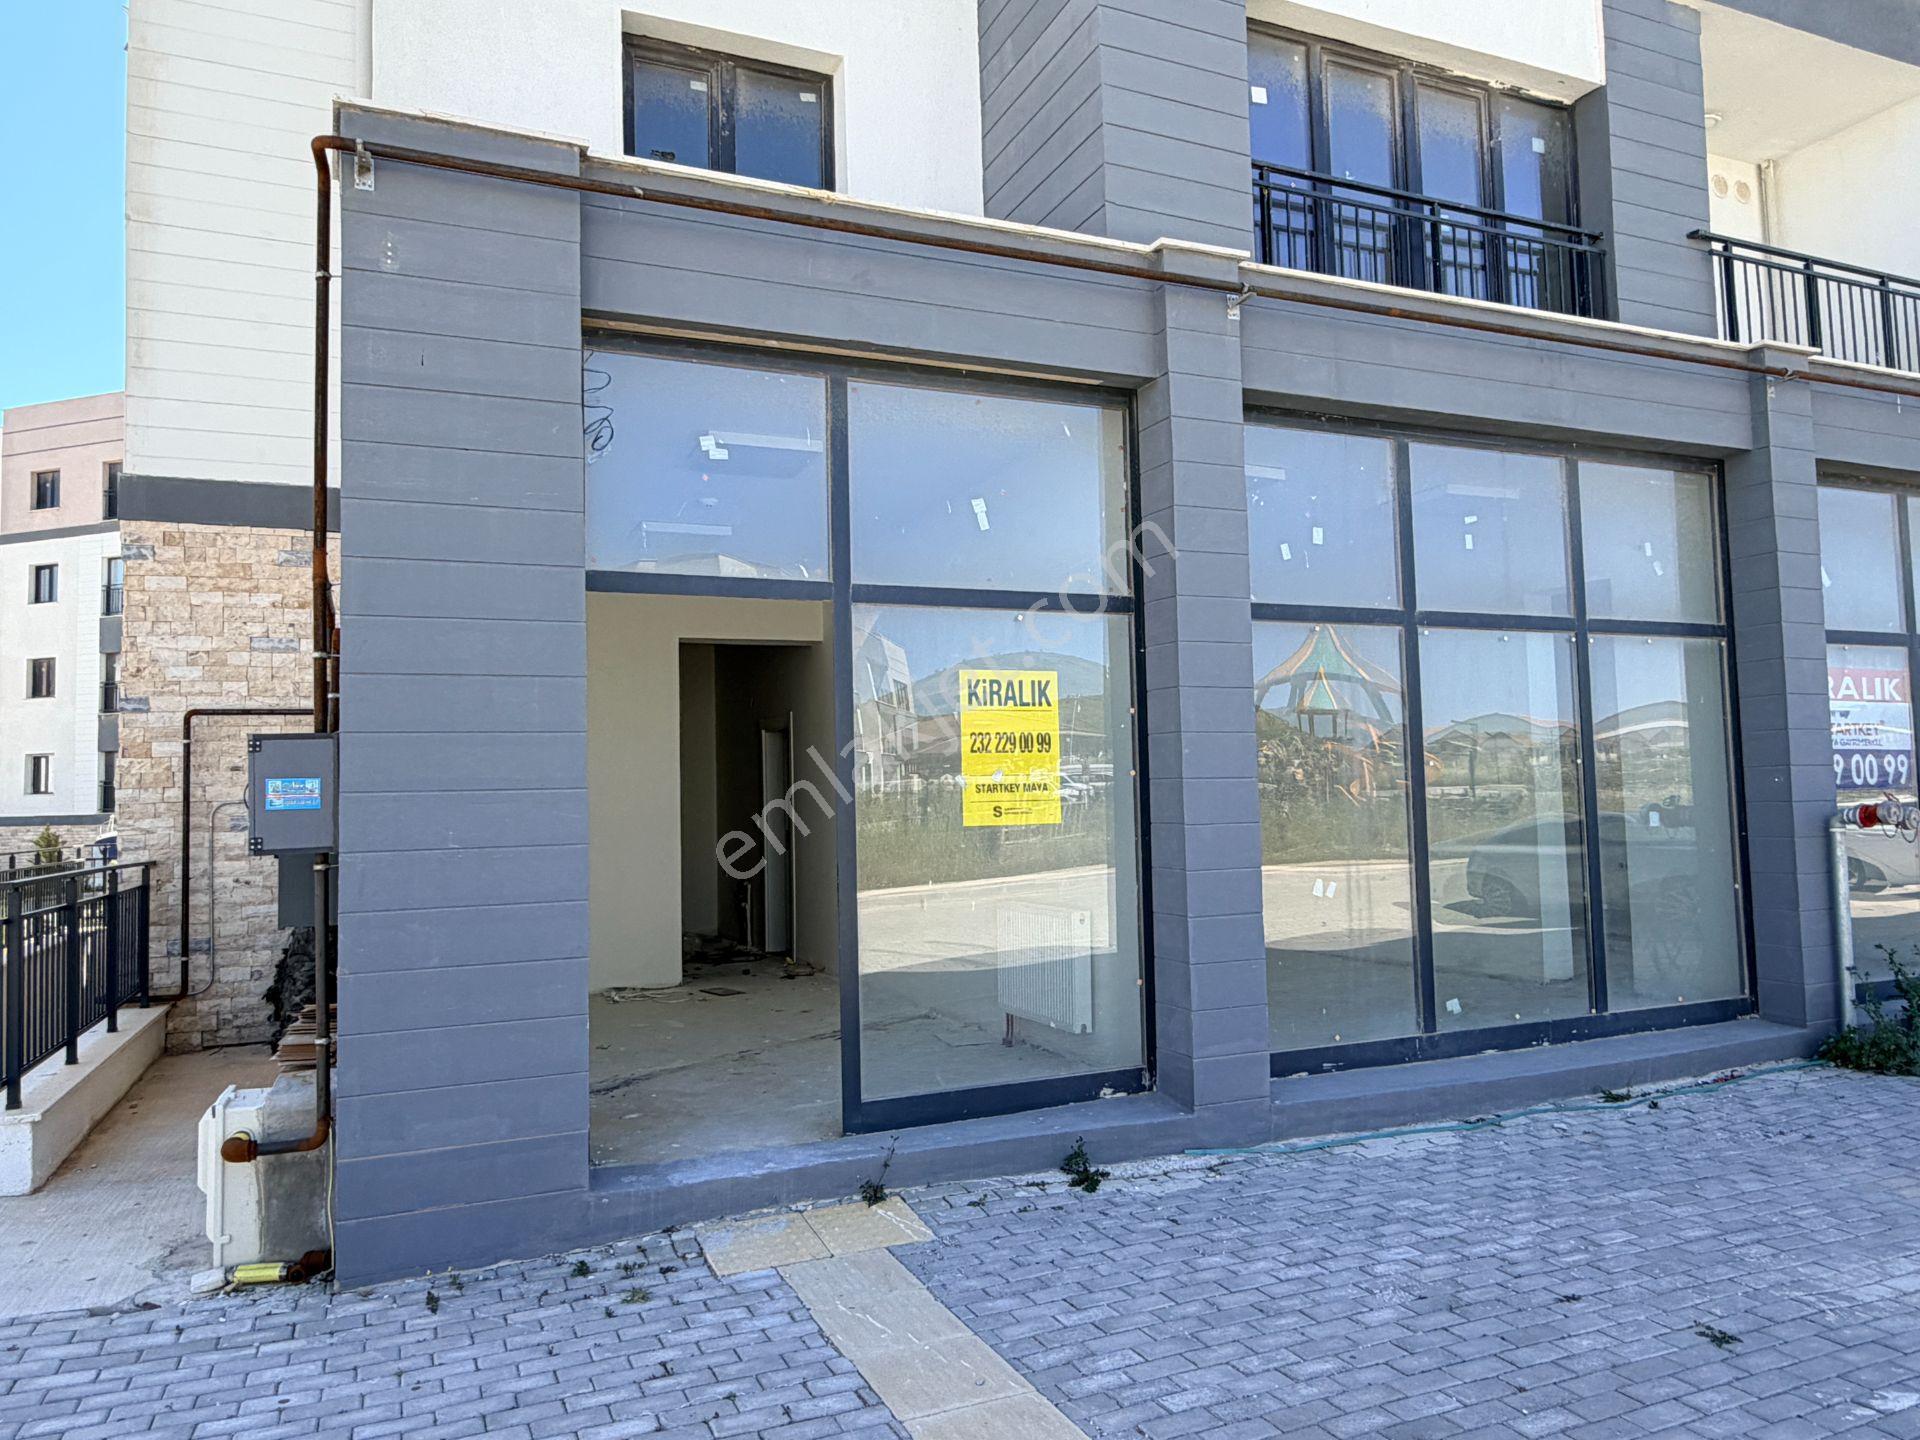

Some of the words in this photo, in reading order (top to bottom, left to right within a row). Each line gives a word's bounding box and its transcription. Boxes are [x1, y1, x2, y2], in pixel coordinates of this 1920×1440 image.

[970, 732, 992, 754] 232
[994, 732, 1016, 754] 229
[1019, 732, 1034, 754] 00
[1038, 732, 1052, 754] 99
[1851, 753, 1878, 785] 00
[1883, 753, 1908, 785] 99
[975, 783, 1020, 794] STARTKEY
[1023, 782, 1048, 793] MAYA
